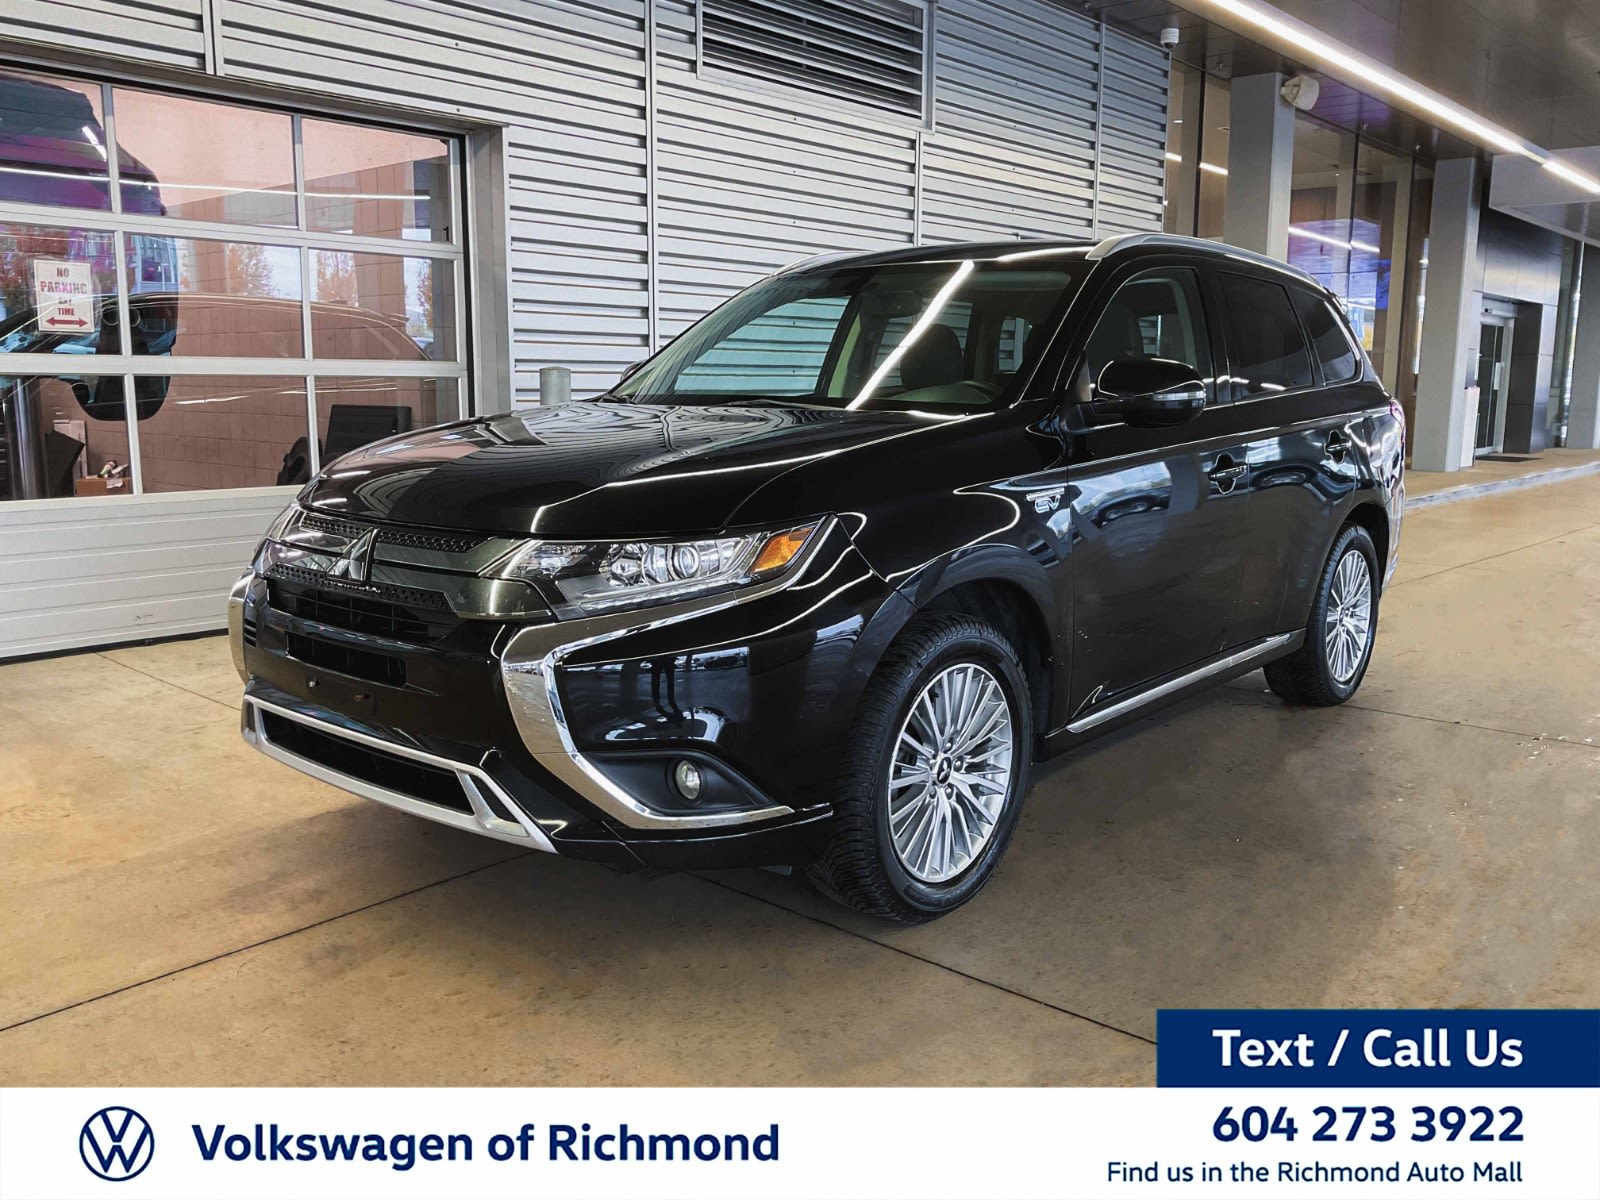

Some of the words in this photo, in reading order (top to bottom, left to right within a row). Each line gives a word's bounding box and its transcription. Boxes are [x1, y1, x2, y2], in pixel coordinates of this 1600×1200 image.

[57, 267, 69, 278] NO
[40, 281, 87, 294] PARKING
[57, 308, 75, 316] TIME
